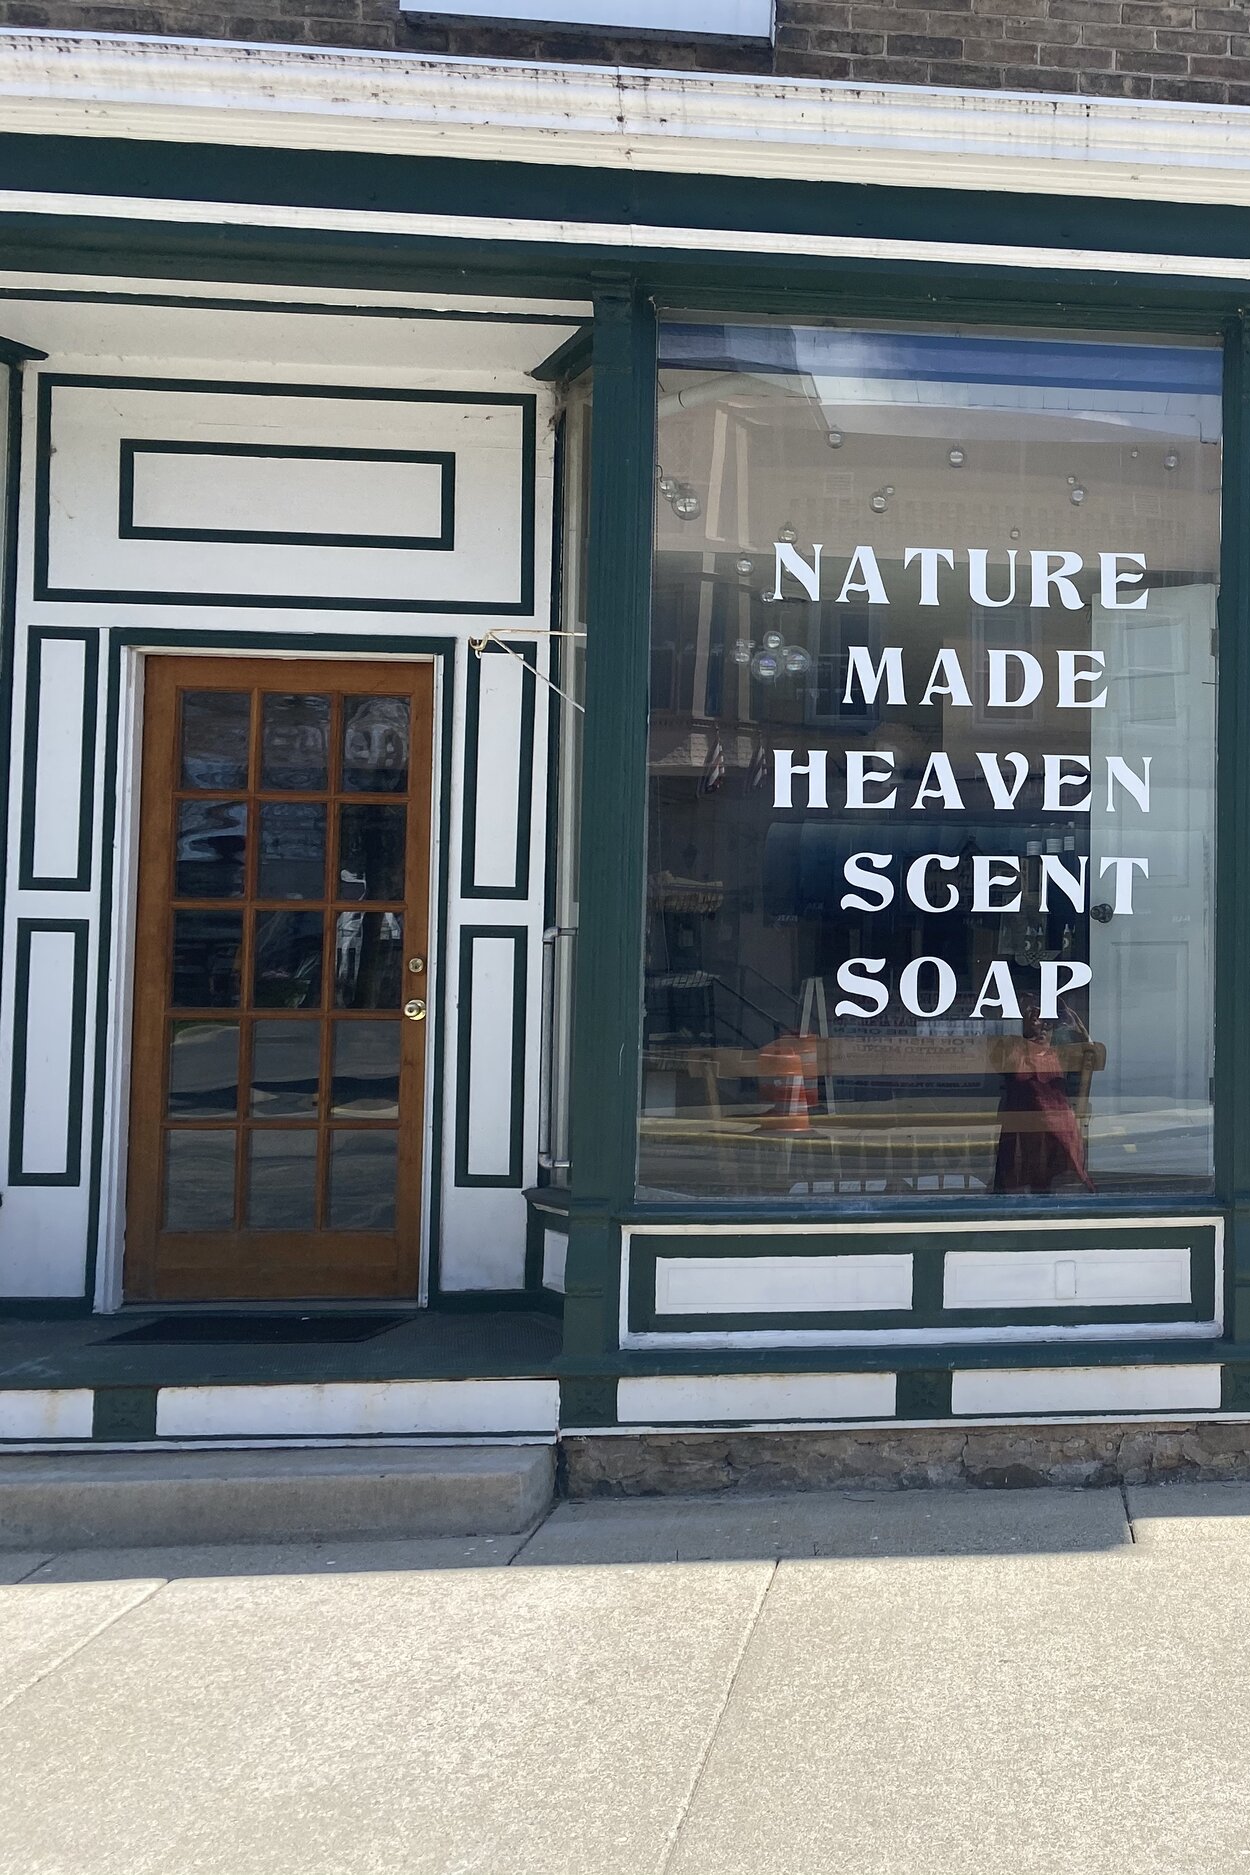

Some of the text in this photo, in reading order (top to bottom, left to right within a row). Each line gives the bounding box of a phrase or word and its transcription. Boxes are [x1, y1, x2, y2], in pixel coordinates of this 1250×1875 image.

[772, 542, 1149, 610] NATURE
[842, 646, 1108, 708] MADE
[772, 749, 1153, 813] HEAVEN
[840, 852, 1149, 915] SCENT
[834, 956, 1093, 1019] SOAP
